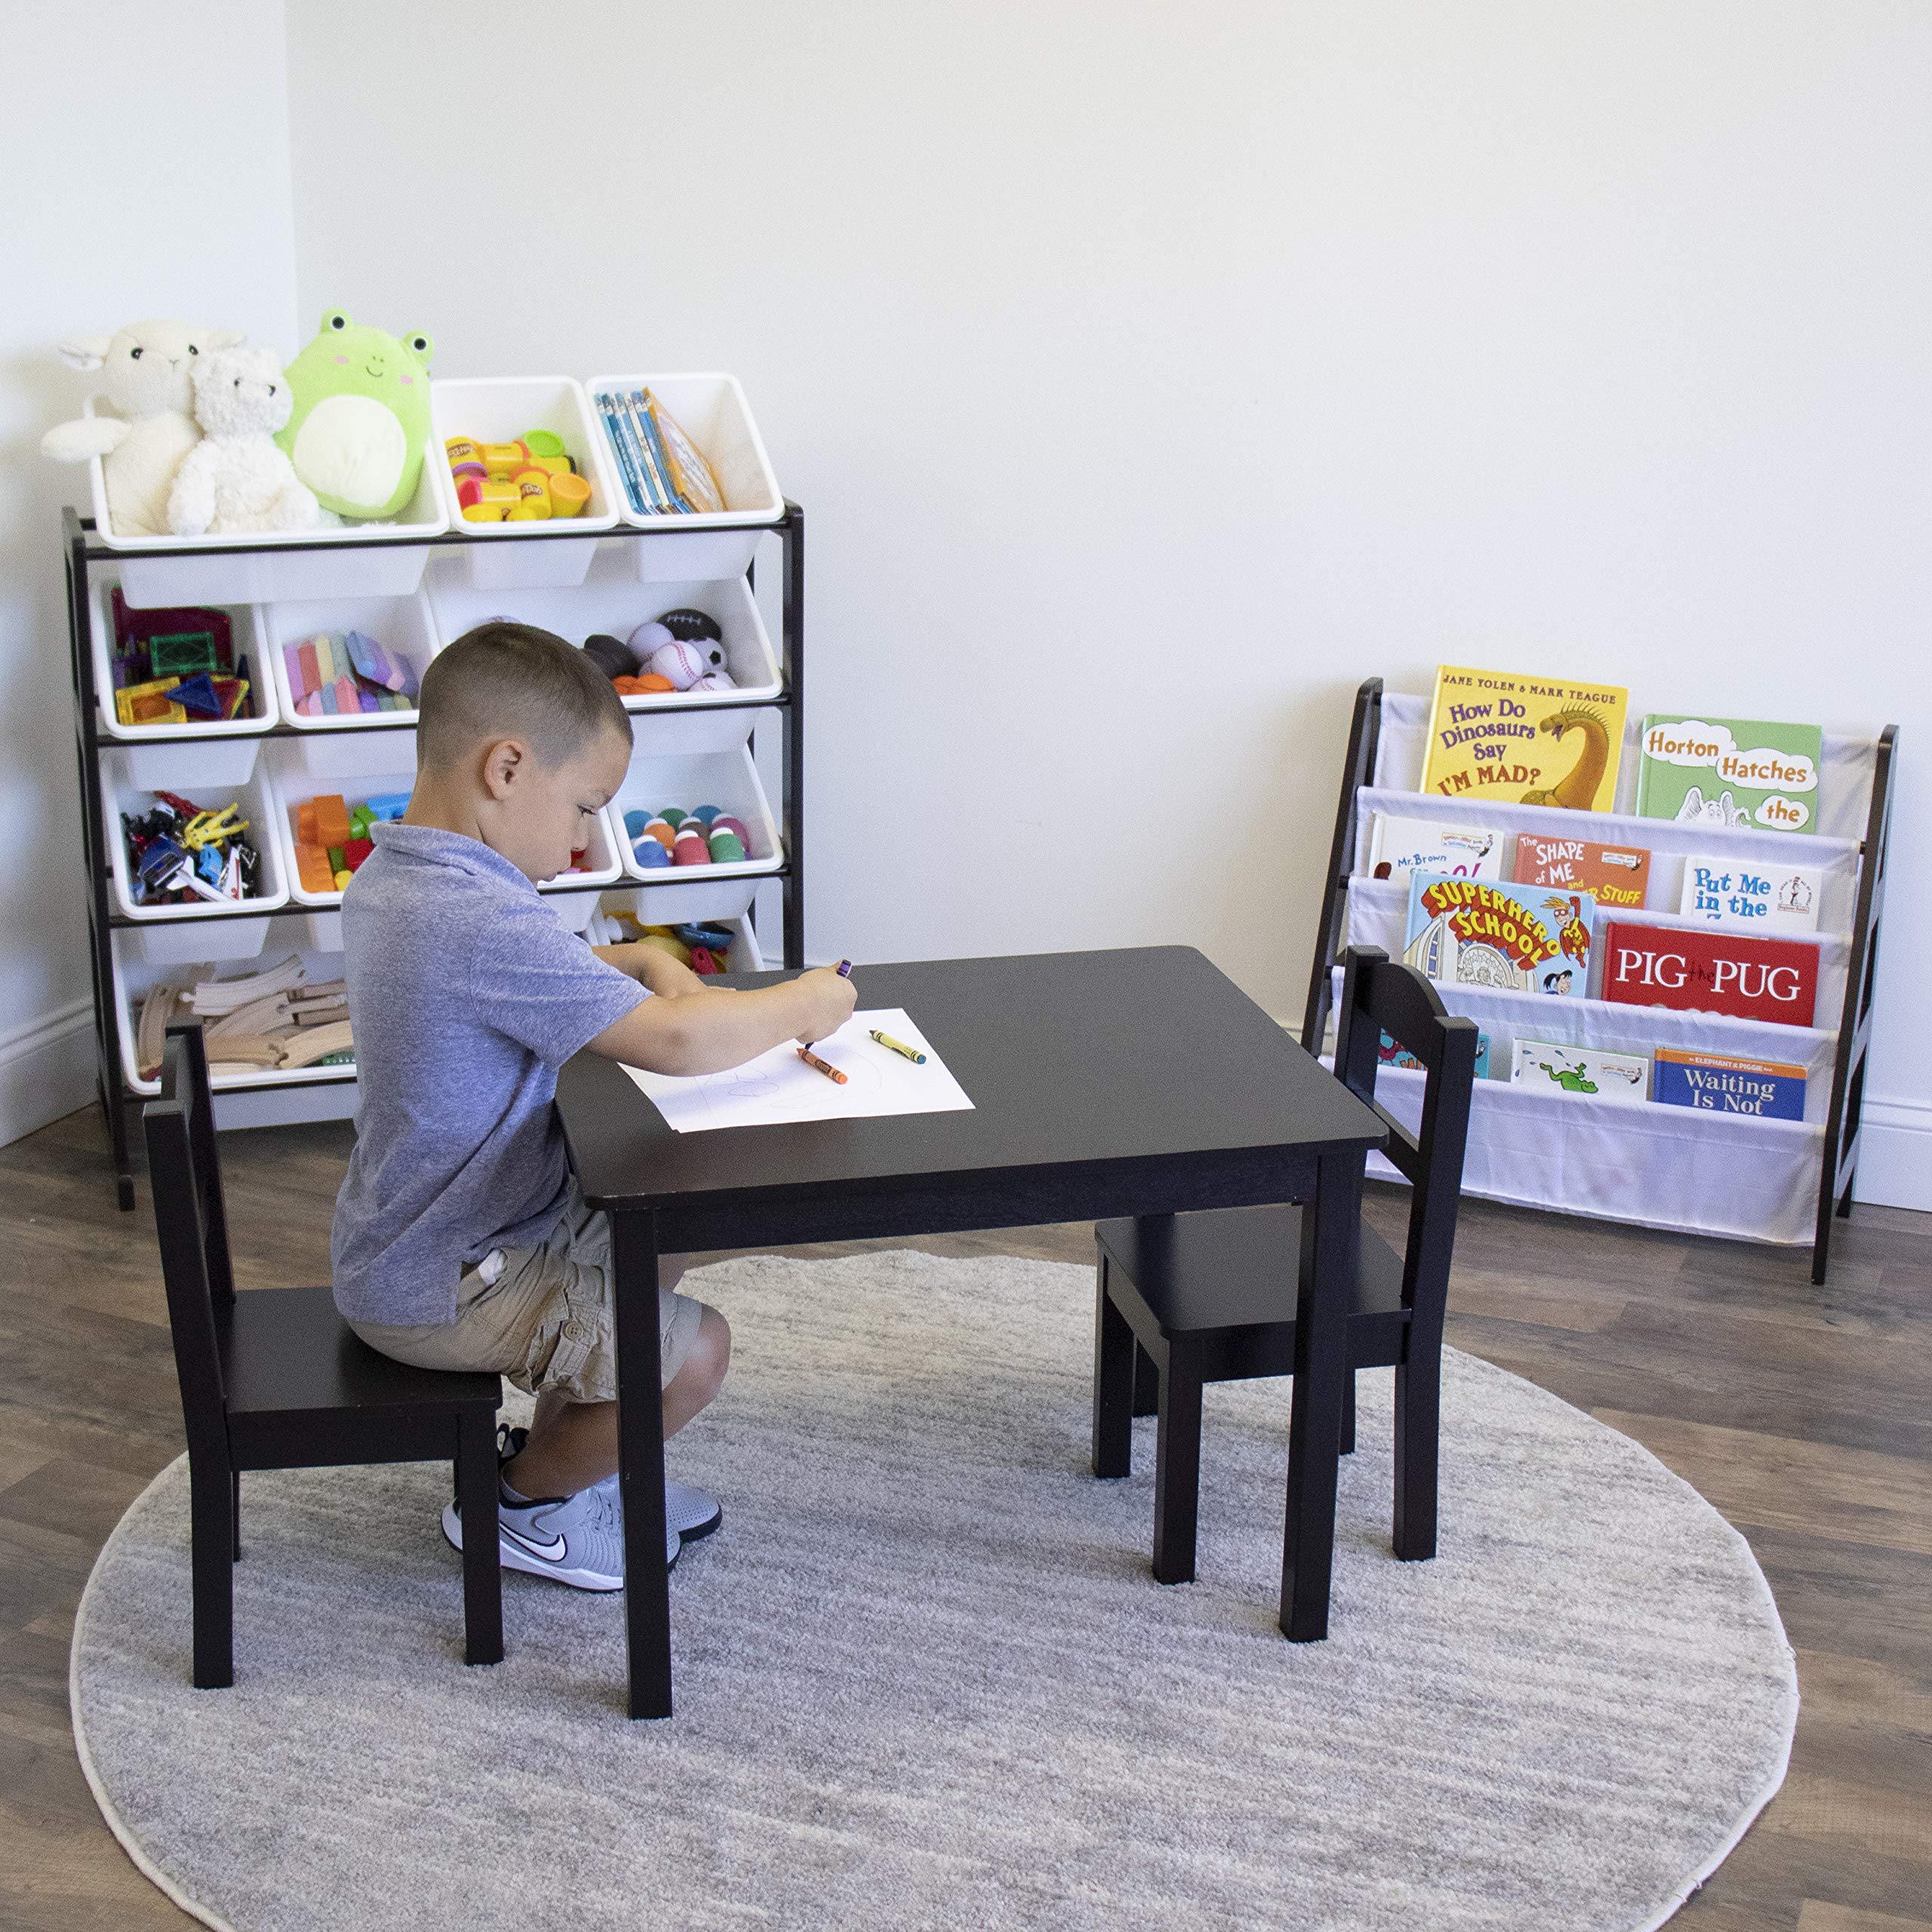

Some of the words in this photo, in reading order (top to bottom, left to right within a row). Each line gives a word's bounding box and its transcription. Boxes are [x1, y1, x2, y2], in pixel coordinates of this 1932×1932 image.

[1443, 675, 1472, 686] JANE
[1477, 678, 1515, 691] YOLEN
[1519, 685, 1526, 693] &
[1530, 685, 1564, 698] MARK
[1569, 690, 1616, 704] TEAGUE
[1449, 703, 1493, 724] How
[1499, 699, 1526, 718] Do
[1441, 722, 1536, 749] Dinosaurs
[1649, 731, 1718, 757] Horton
[1473, 743, 1507, 761] Say
[1437, 771, 1472, 796] I'M
[1477, 764, 1541, 786] MAD?
[1722, 757, 1807, 783] Hatches
[1767, 800, 1800, 822] the
[1520, 836, 1537, 848] The
[1536, 841, 1584, 866] SHAPE
[1413, 854, 1447, 866] Brown
[1535, 870, 1545, 884] of
[1549, 863, 1574, 884] ME
[1567, 879, 1584, 890] and
[1694, 868, 1731, 893] Put
[1737, 874, 1770, 896] Me
[1600, 884, 1641, 904] STUFF
[1695, 890, 1719, 911] in
[1728, 895, 1767, 917] the
[1429, 881, 1560, 956] SUPERHERO
[1456, 911, 1543, 966] SCHOOL
[1615, 949, 1687, 988] PIG
[1710, 959, 1801, 1001] PUG
[1694, 1057, 1732, 1068] ELEPHANT
[1739, 1063, 1763, 1071] PIGGIE
[1684, 1069, 1775, 1102] Waiting
[1693, 1089, 1714, 1108] Is
[1724, 1094, 1763, 1115] Not
